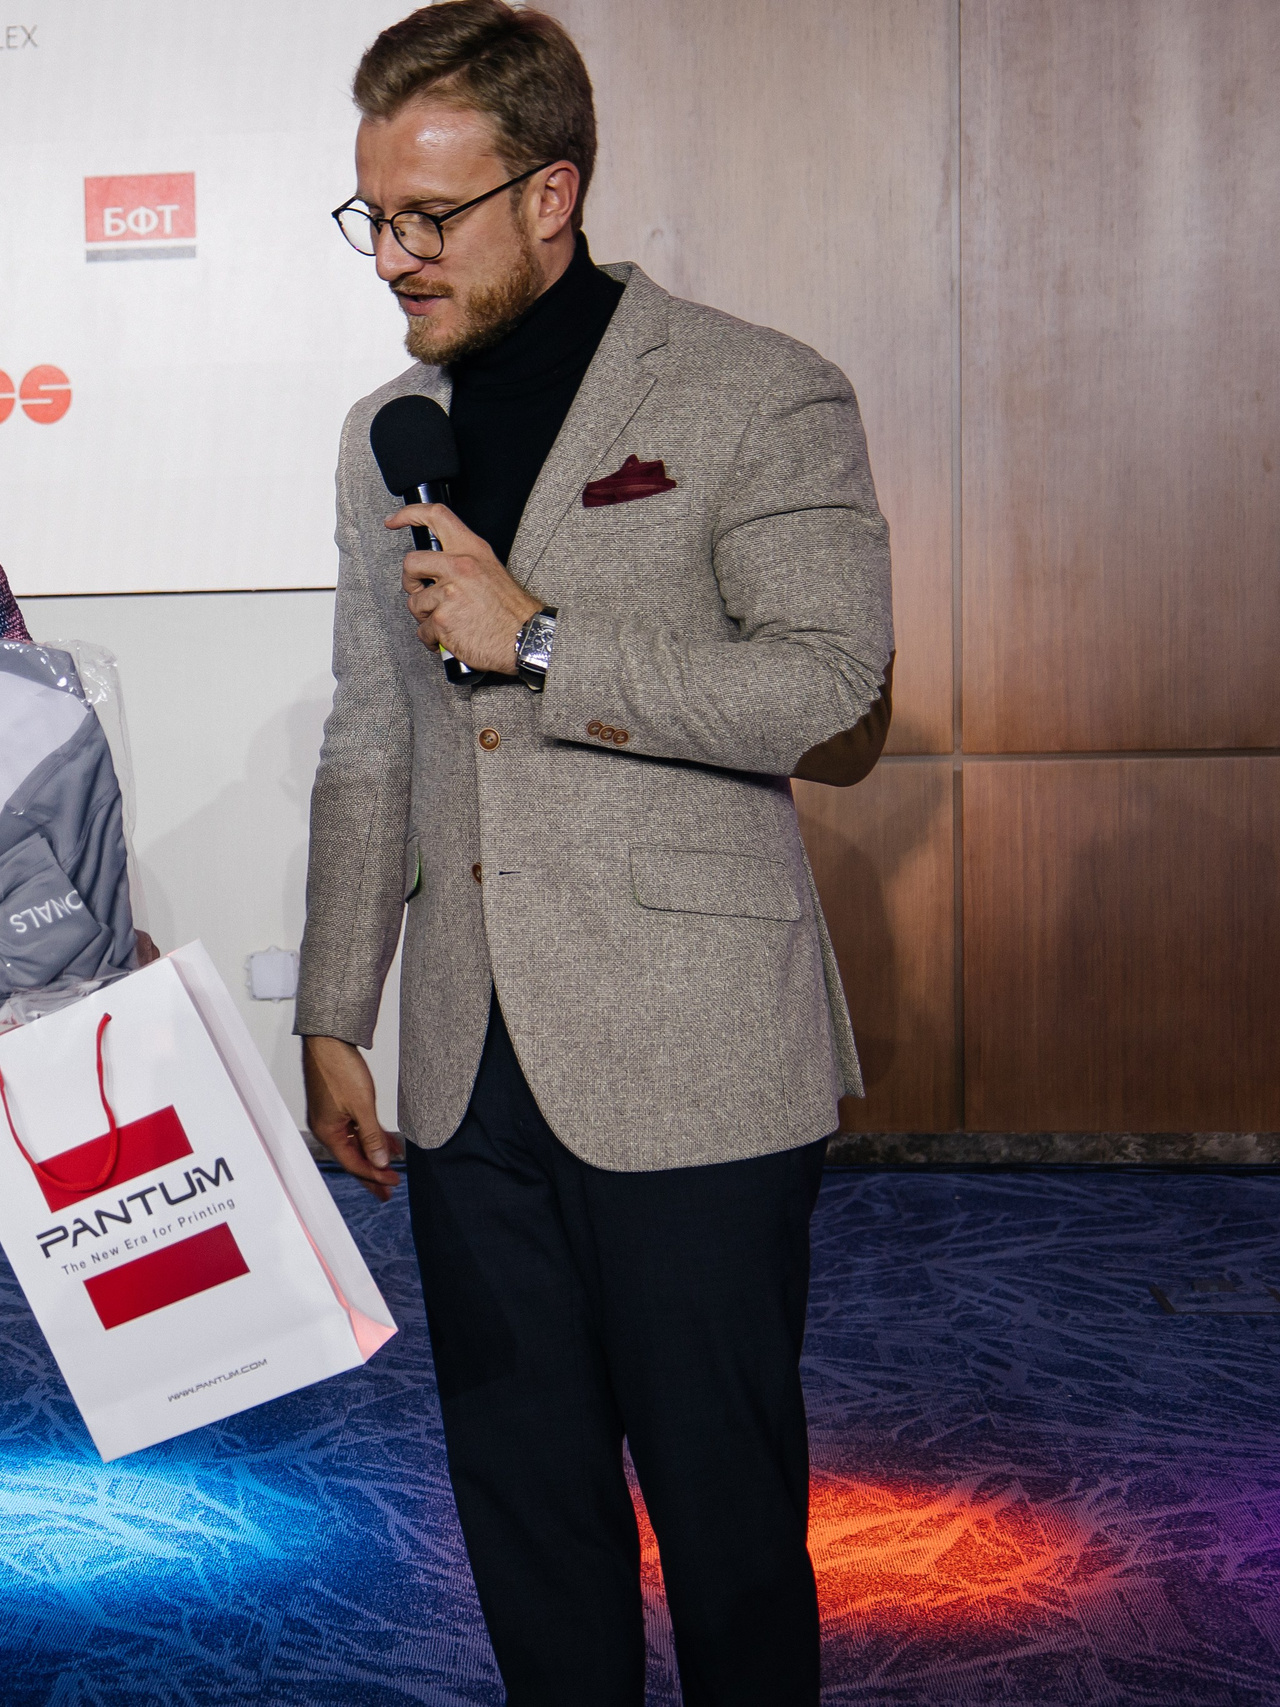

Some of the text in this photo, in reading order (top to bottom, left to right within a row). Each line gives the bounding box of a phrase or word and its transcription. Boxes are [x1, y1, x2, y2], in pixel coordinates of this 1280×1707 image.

[103, 203, 181, 236] БФТ
[35, 1156, 235, 1260] PANTUM
[61, 1198, 236, 1276] The New Era for Printing
[167, 1358, 269, 1403] WWW.PANTUM.COM
